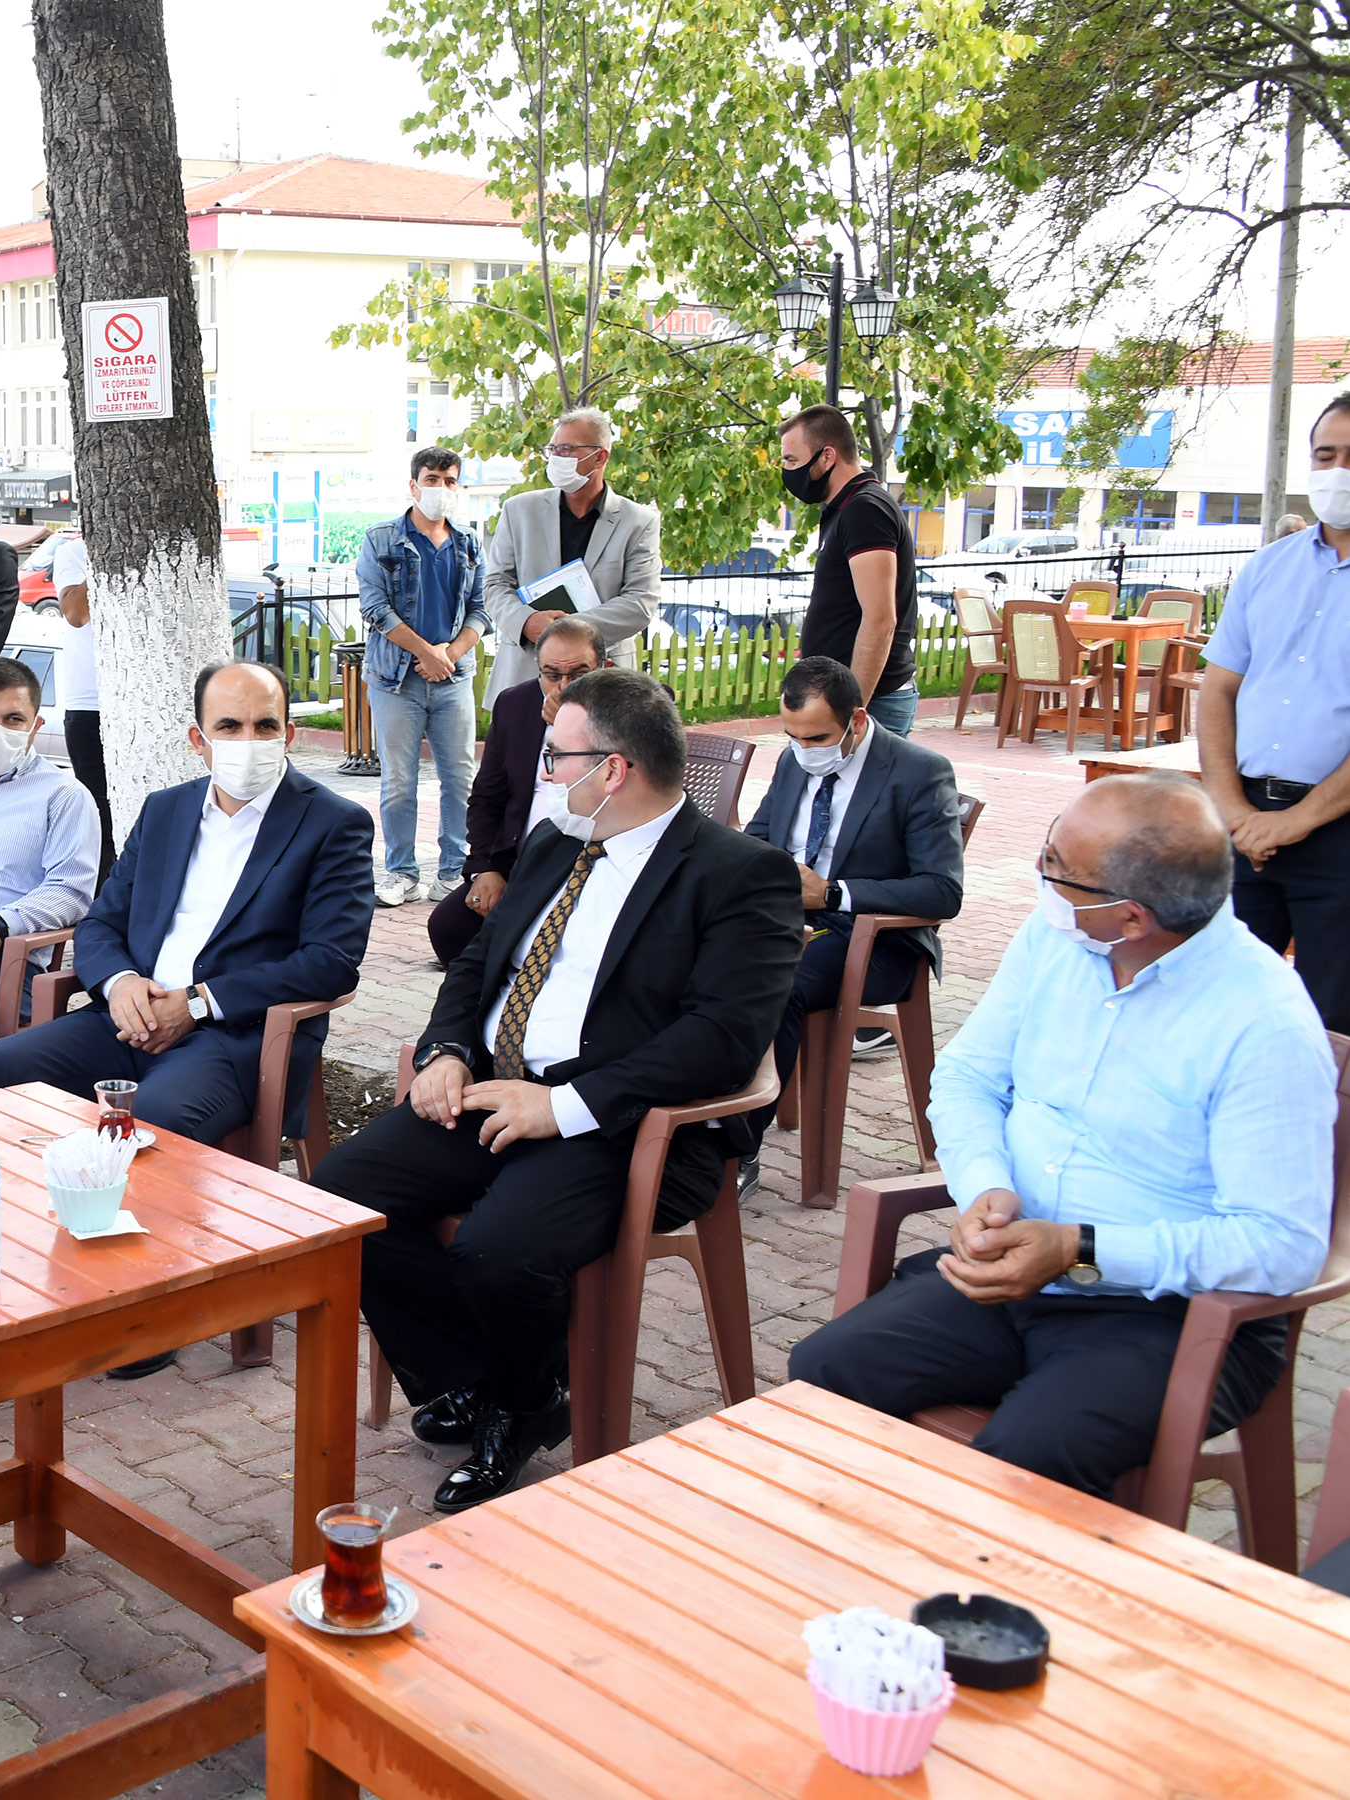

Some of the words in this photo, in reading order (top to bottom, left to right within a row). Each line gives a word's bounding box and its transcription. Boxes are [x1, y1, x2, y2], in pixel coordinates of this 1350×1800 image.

[101, 380, 110, 389] VE
[106, 389, 148, 402] LÜTFEN
[95, 403, 123, 413] YERLERE
[125, 401, 159, 412] ATMAYINIZ
